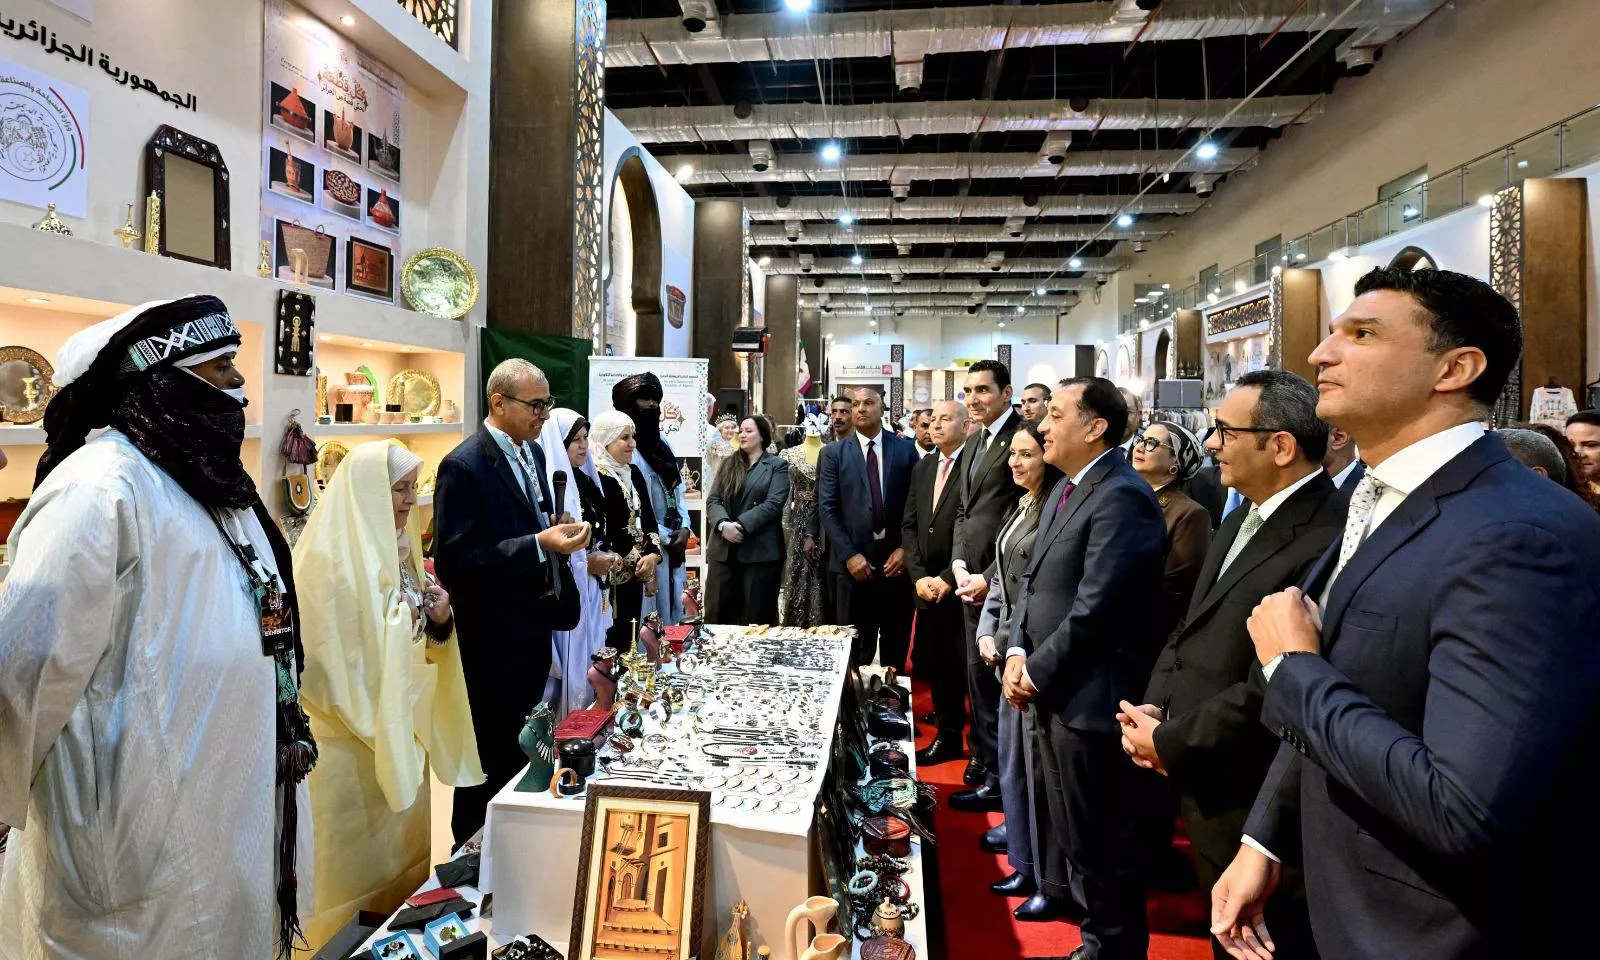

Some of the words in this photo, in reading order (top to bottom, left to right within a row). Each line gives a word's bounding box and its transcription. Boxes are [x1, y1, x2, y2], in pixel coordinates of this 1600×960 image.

[0, 11, 93, 66] الجزائري
[99, 52, 197, 112] الجمهورية
[264, 626, 292, 637] EXHIBITOR
